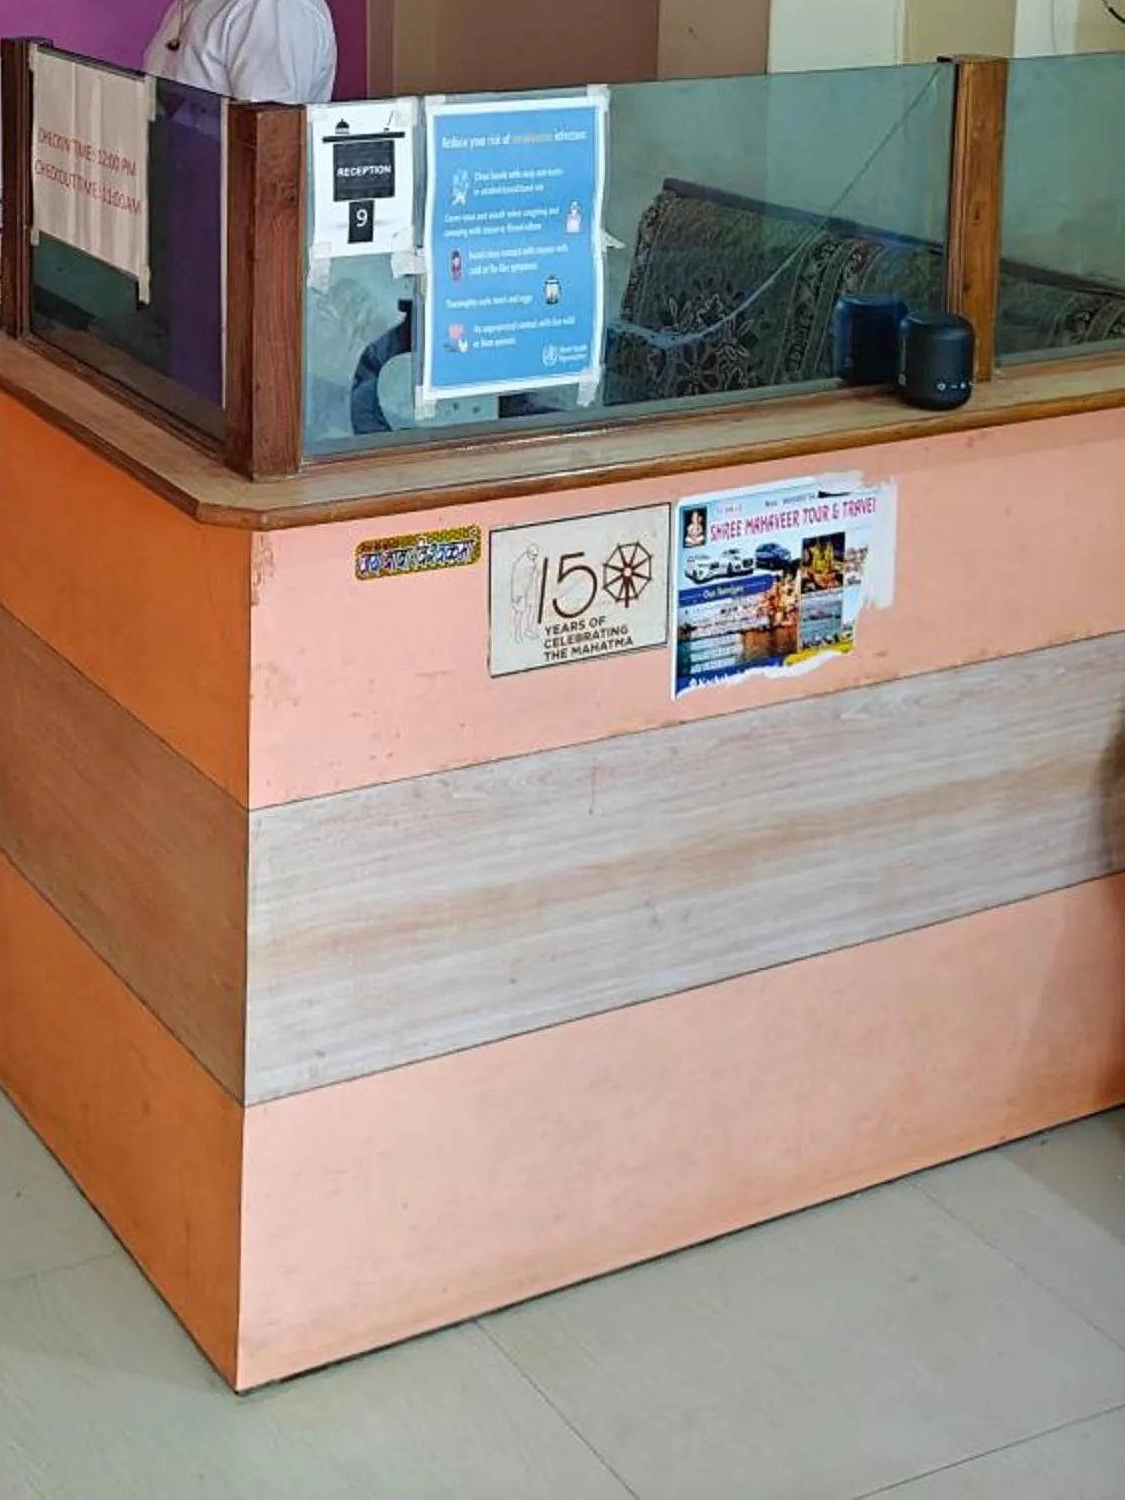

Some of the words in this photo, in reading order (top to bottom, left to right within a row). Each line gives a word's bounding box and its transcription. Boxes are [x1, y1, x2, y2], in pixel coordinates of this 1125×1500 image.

[121, 157, 138, 176] PM
[336, 164, 392, 177] RECEPTION
[356, 208, 368, 227] 9
[710, 522, 743, 542] SHREE
[744, 509, 801, 535] MAHAVEER
[802, 504, 830, 524] TOUR
[831, 503, 840, 520] &
[544, 621, 586, 636] YEARS
[588, 615, 606, 629] OF
[543, 624, 629, 649] CELEBRATING
[544, 647, 568, 662] THE
[570, 636, 634, 657] MAHATMA
